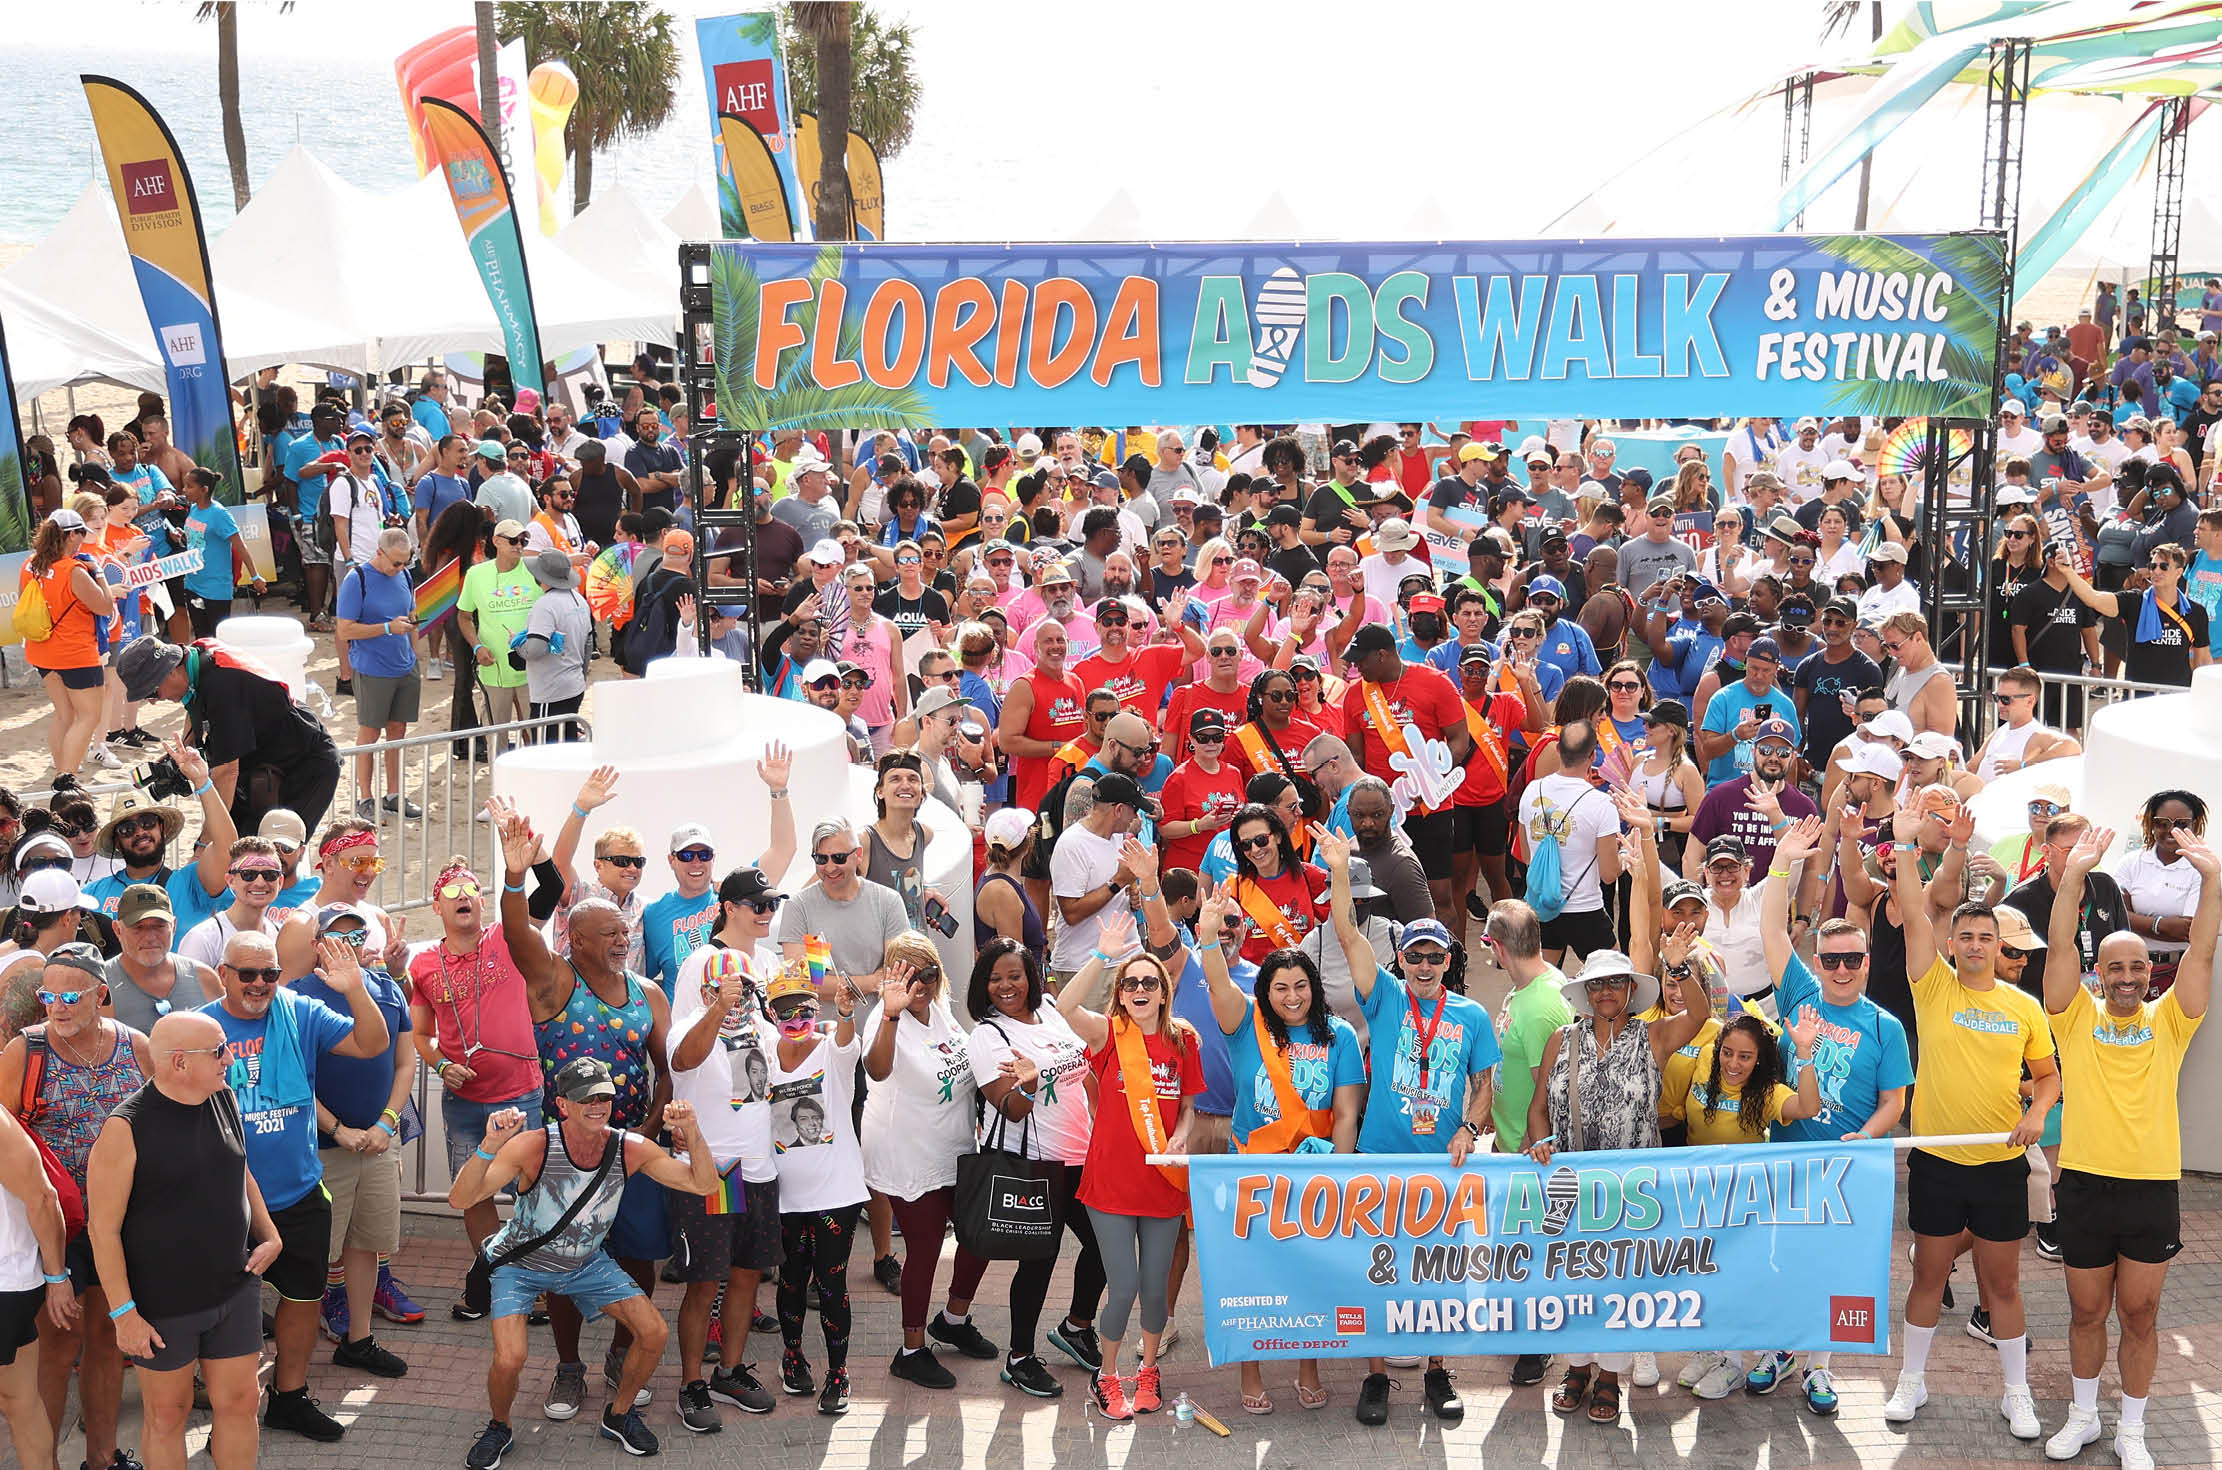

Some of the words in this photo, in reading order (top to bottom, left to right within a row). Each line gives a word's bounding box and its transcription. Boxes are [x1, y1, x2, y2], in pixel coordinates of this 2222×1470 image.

[726, 83, 768, 113] AHF
[133, 175, 167, 198] AHF
[131, 218, 183, 232] DIVISION
[154, 211, 181, 220] HEALTH
[1763, 268, 1798, 322] &
[1815, 270, 1953, 323] MUSIC
[485, 259, 527, 369] PHARMACY
[753, 276, 1163, 389] FLORIDA
[1452, 273, 1731, 381] WALK
[170, 335, 196, 354] AHF
[1756, 332, 1950, 382] FESTIVAL
[1674, 518, 1695, 531] WITH
[893, 612, 929, 625] AQUA
[1435, 770, 1463, 799] UNITED
[1733, 811, 1749, 821] YOU
[1731, 823, 1744, 833] TO
[1746, 824, 1757, 833] BE
[1744, 836, 1755, 845] BE
[1952, 1012, 2019, 1034] LAUDERDALE
[2093, 1025, 2154, 1046] LAUDERDALE
[229, 1037, 265, 1058] FLOR
[945, 1047, 967, 1067] RADIC
[937, 1060, 971, 1081] COOPER
[245, 1112, 268, 1122] MUSIC
[270, 1106, 299, 1119] FESTIVAL
[1138, 1097, 1151, 1113] Top
[255, 1118, 285, 1134] 2021
[1233, 1173, 1488, 1240] FLORIDA
[1670, 1157, 1853, 1229] WALK
[1367, 1242, 1397, 1285] &
[1411, 1243, 1531, 1285] MUSIC
[1544, 1236, 1718, 1281] FESTIVAL
[1220, 1296, 1273, 1308] PRESENTED
[1275, 1295, 1288, 1305] BY
[1386, 1298, 1513, 1333] MARCH
[1524, 1294, 1593, 1331] 19TH
[1604, 1290, 1702, 1329] 2022
[1836, 1309, 1869, 1328] AHF
[1221, 1318, 1237, 1328] AHF
[1237, 1314, 1325, 1331] PHARMACY
[1252, 1338, 1299, 1350] Office
[1302, 1339, 1348, 1350] DEPOT
